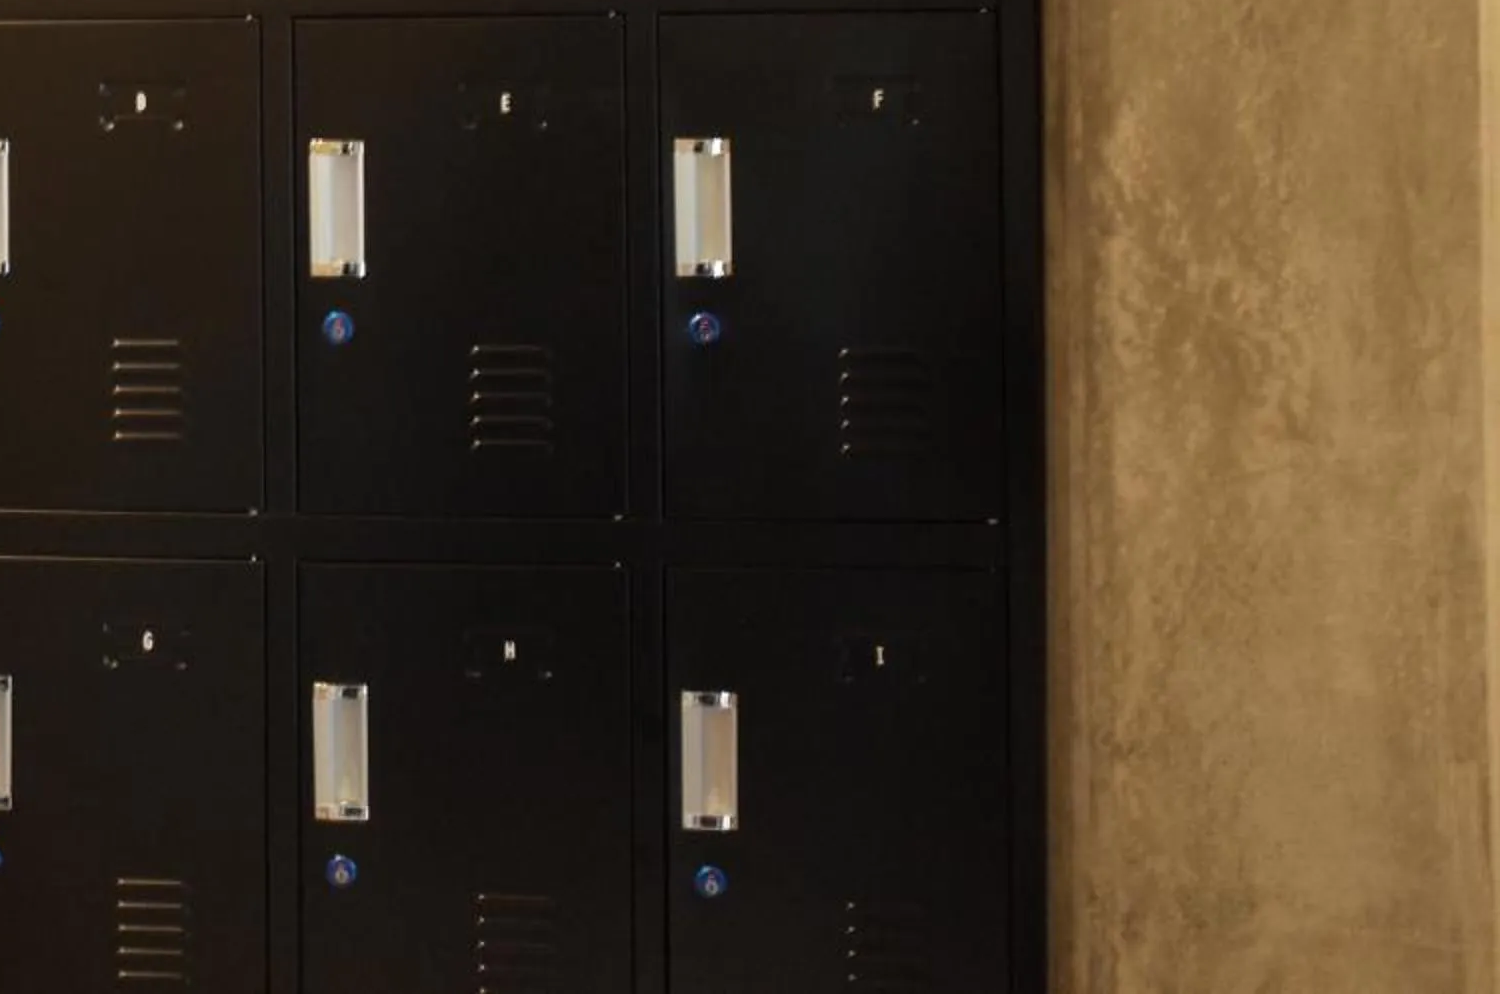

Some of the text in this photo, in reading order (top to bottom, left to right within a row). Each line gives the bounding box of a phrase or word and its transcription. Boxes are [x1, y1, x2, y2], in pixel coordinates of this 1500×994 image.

[135, 91, 148, 113] D
[500, 92, 512, 113] E
[872, 89, 885, 109] F
[142, 630, 155, 651] G
